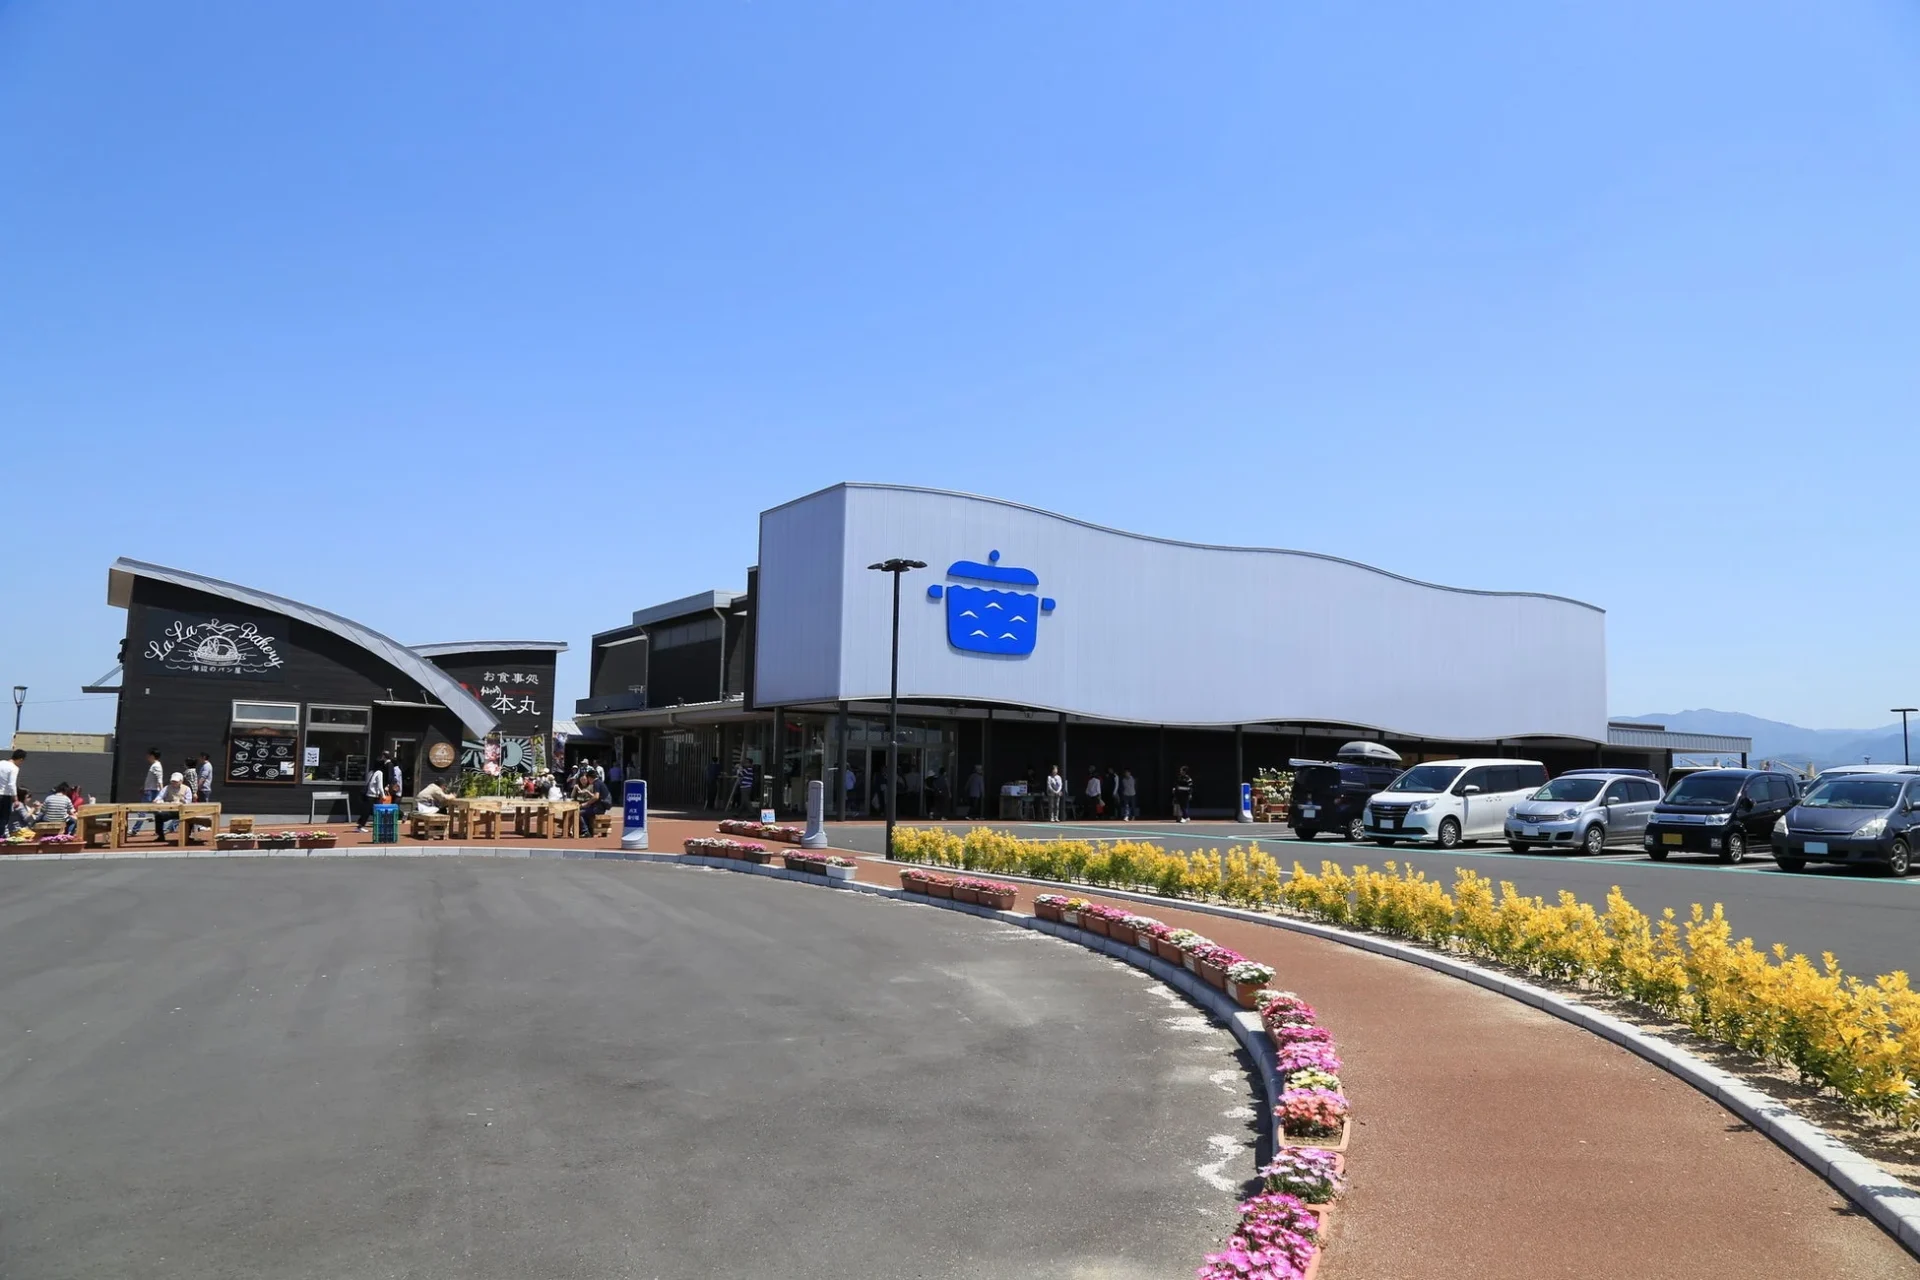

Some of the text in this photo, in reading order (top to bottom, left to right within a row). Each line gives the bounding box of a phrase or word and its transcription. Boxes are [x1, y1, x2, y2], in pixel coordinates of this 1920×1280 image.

[144, 620, 284, 669] La La Bakery
[483, 671, 539, 685] お食事処
[491, 694, 541, 716] 本丸
